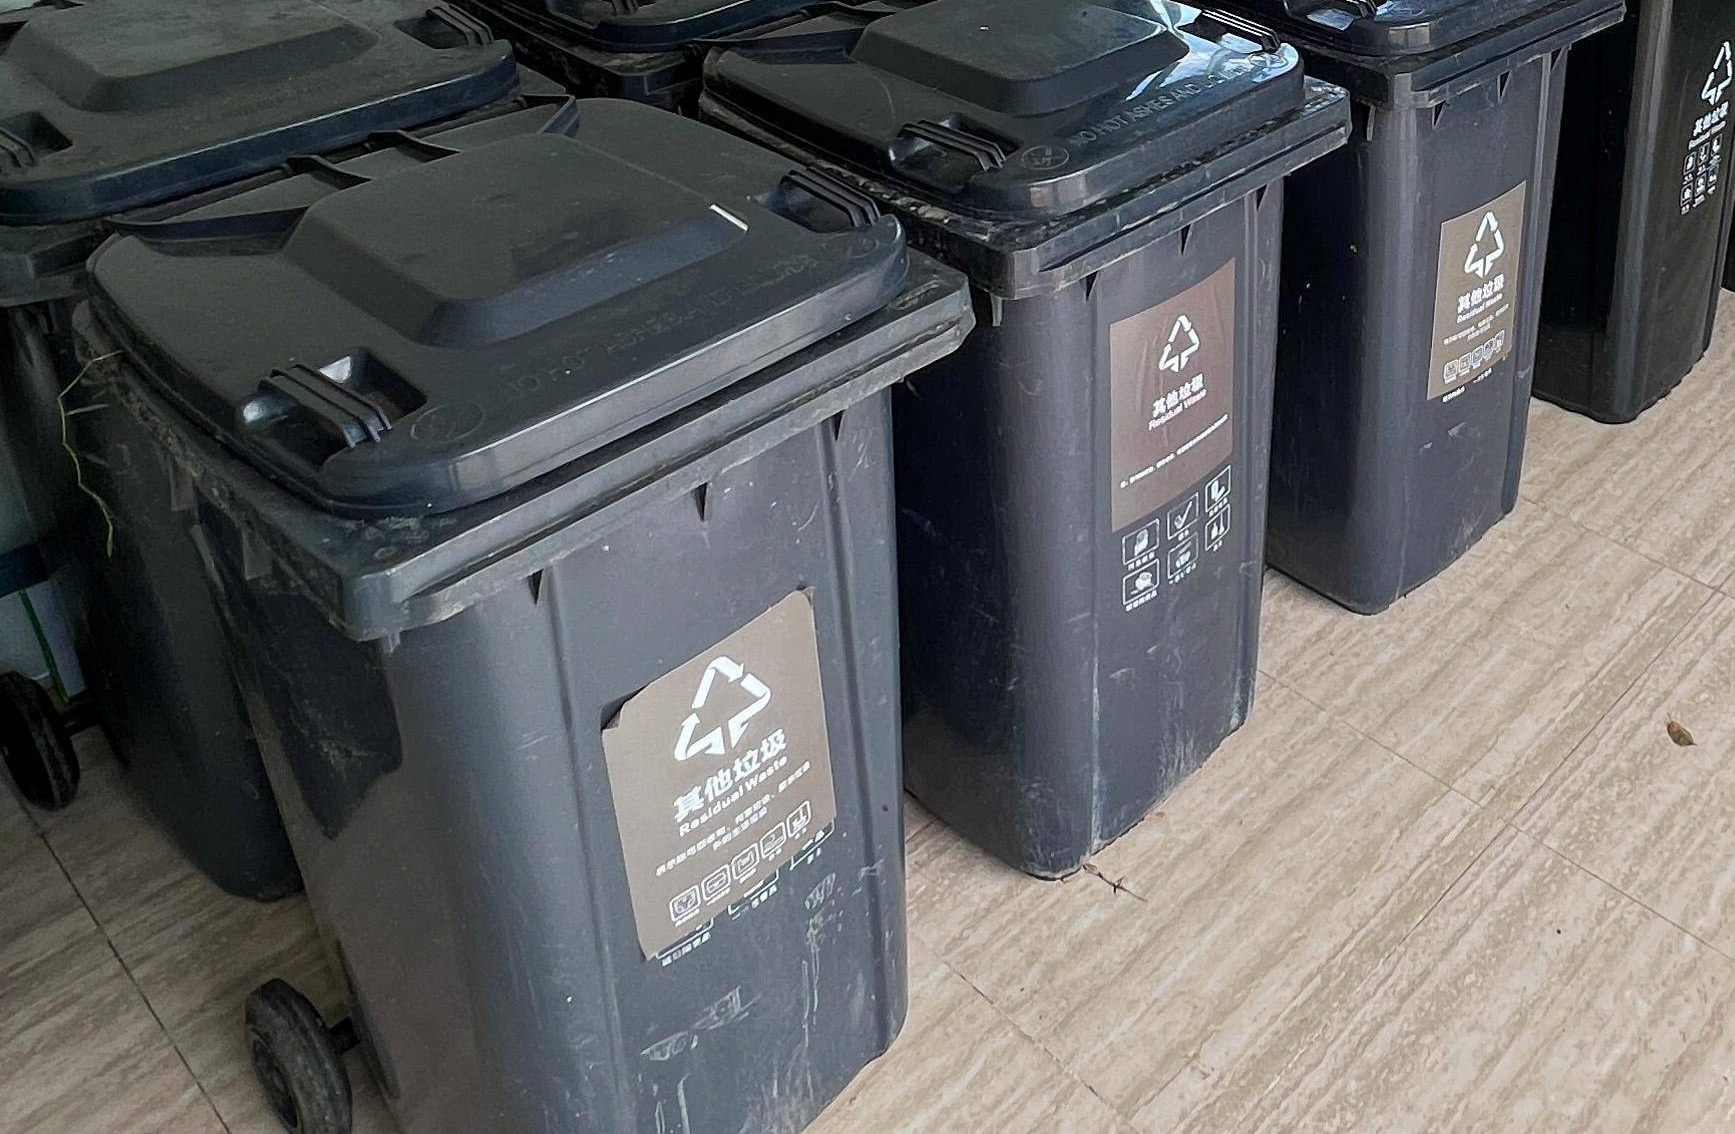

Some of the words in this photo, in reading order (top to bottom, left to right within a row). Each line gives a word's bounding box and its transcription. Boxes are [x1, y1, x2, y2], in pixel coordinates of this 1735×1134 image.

[1091, 115, 1128, 135] HOT
[1123, 95, 1175, 122] ASHES
[1170, 83, 1202, 103] AND
[1457, 273, 1504, 313] 其他垃圾
[1152, 373, 1205, 418] 其他垃圾
[674, 728, 787, 823] 其他垃圾
[679, 784, 744, 837] Residual
[745, 755, 788, 792] Waste
